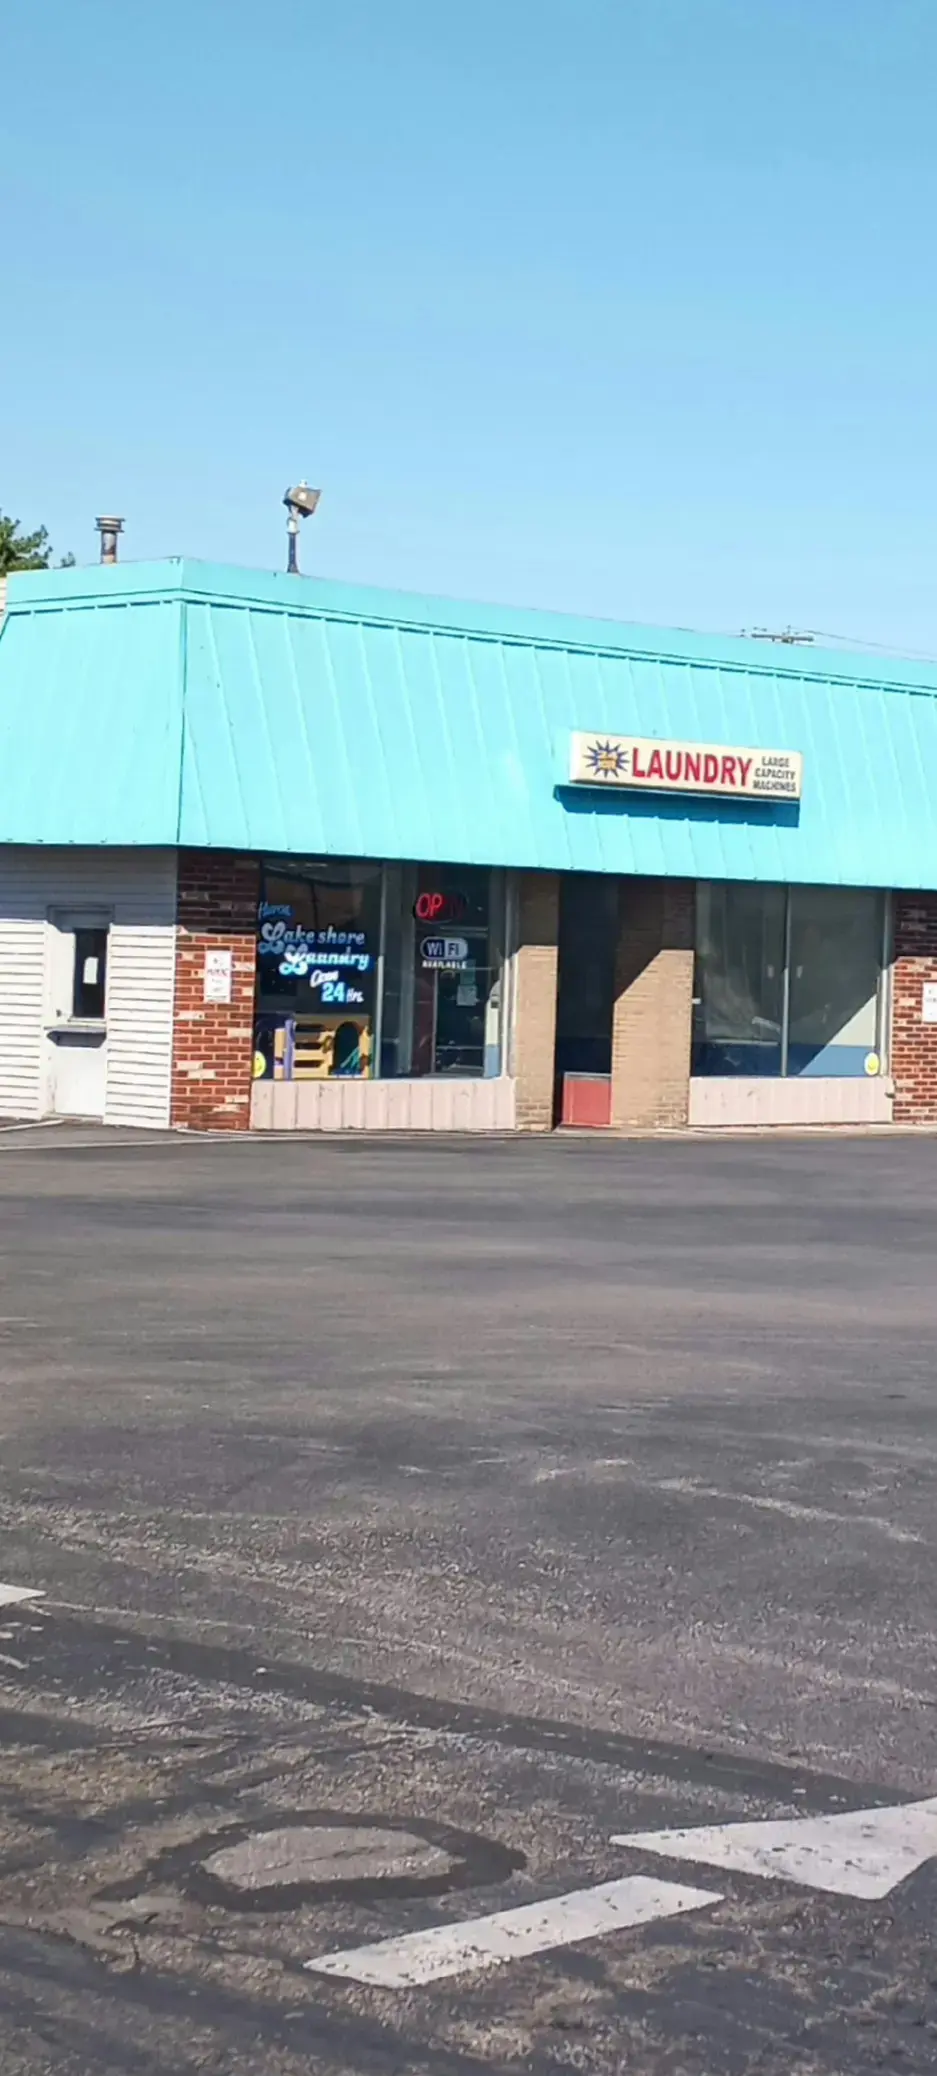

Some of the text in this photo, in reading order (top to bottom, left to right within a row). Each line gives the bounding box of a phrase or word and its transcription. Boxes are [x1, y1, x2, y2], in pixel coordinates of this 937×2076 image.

[632, 747, 752, 787] LAUNDRY
[761, 755, 789, 768] LARGE
[754, 767, 796, 780] CAPACITY
[752, 779, 796, 792] MACHINES
[278, 943, 370, 975] Laundry
[321, 982, 345, 1003] 24
